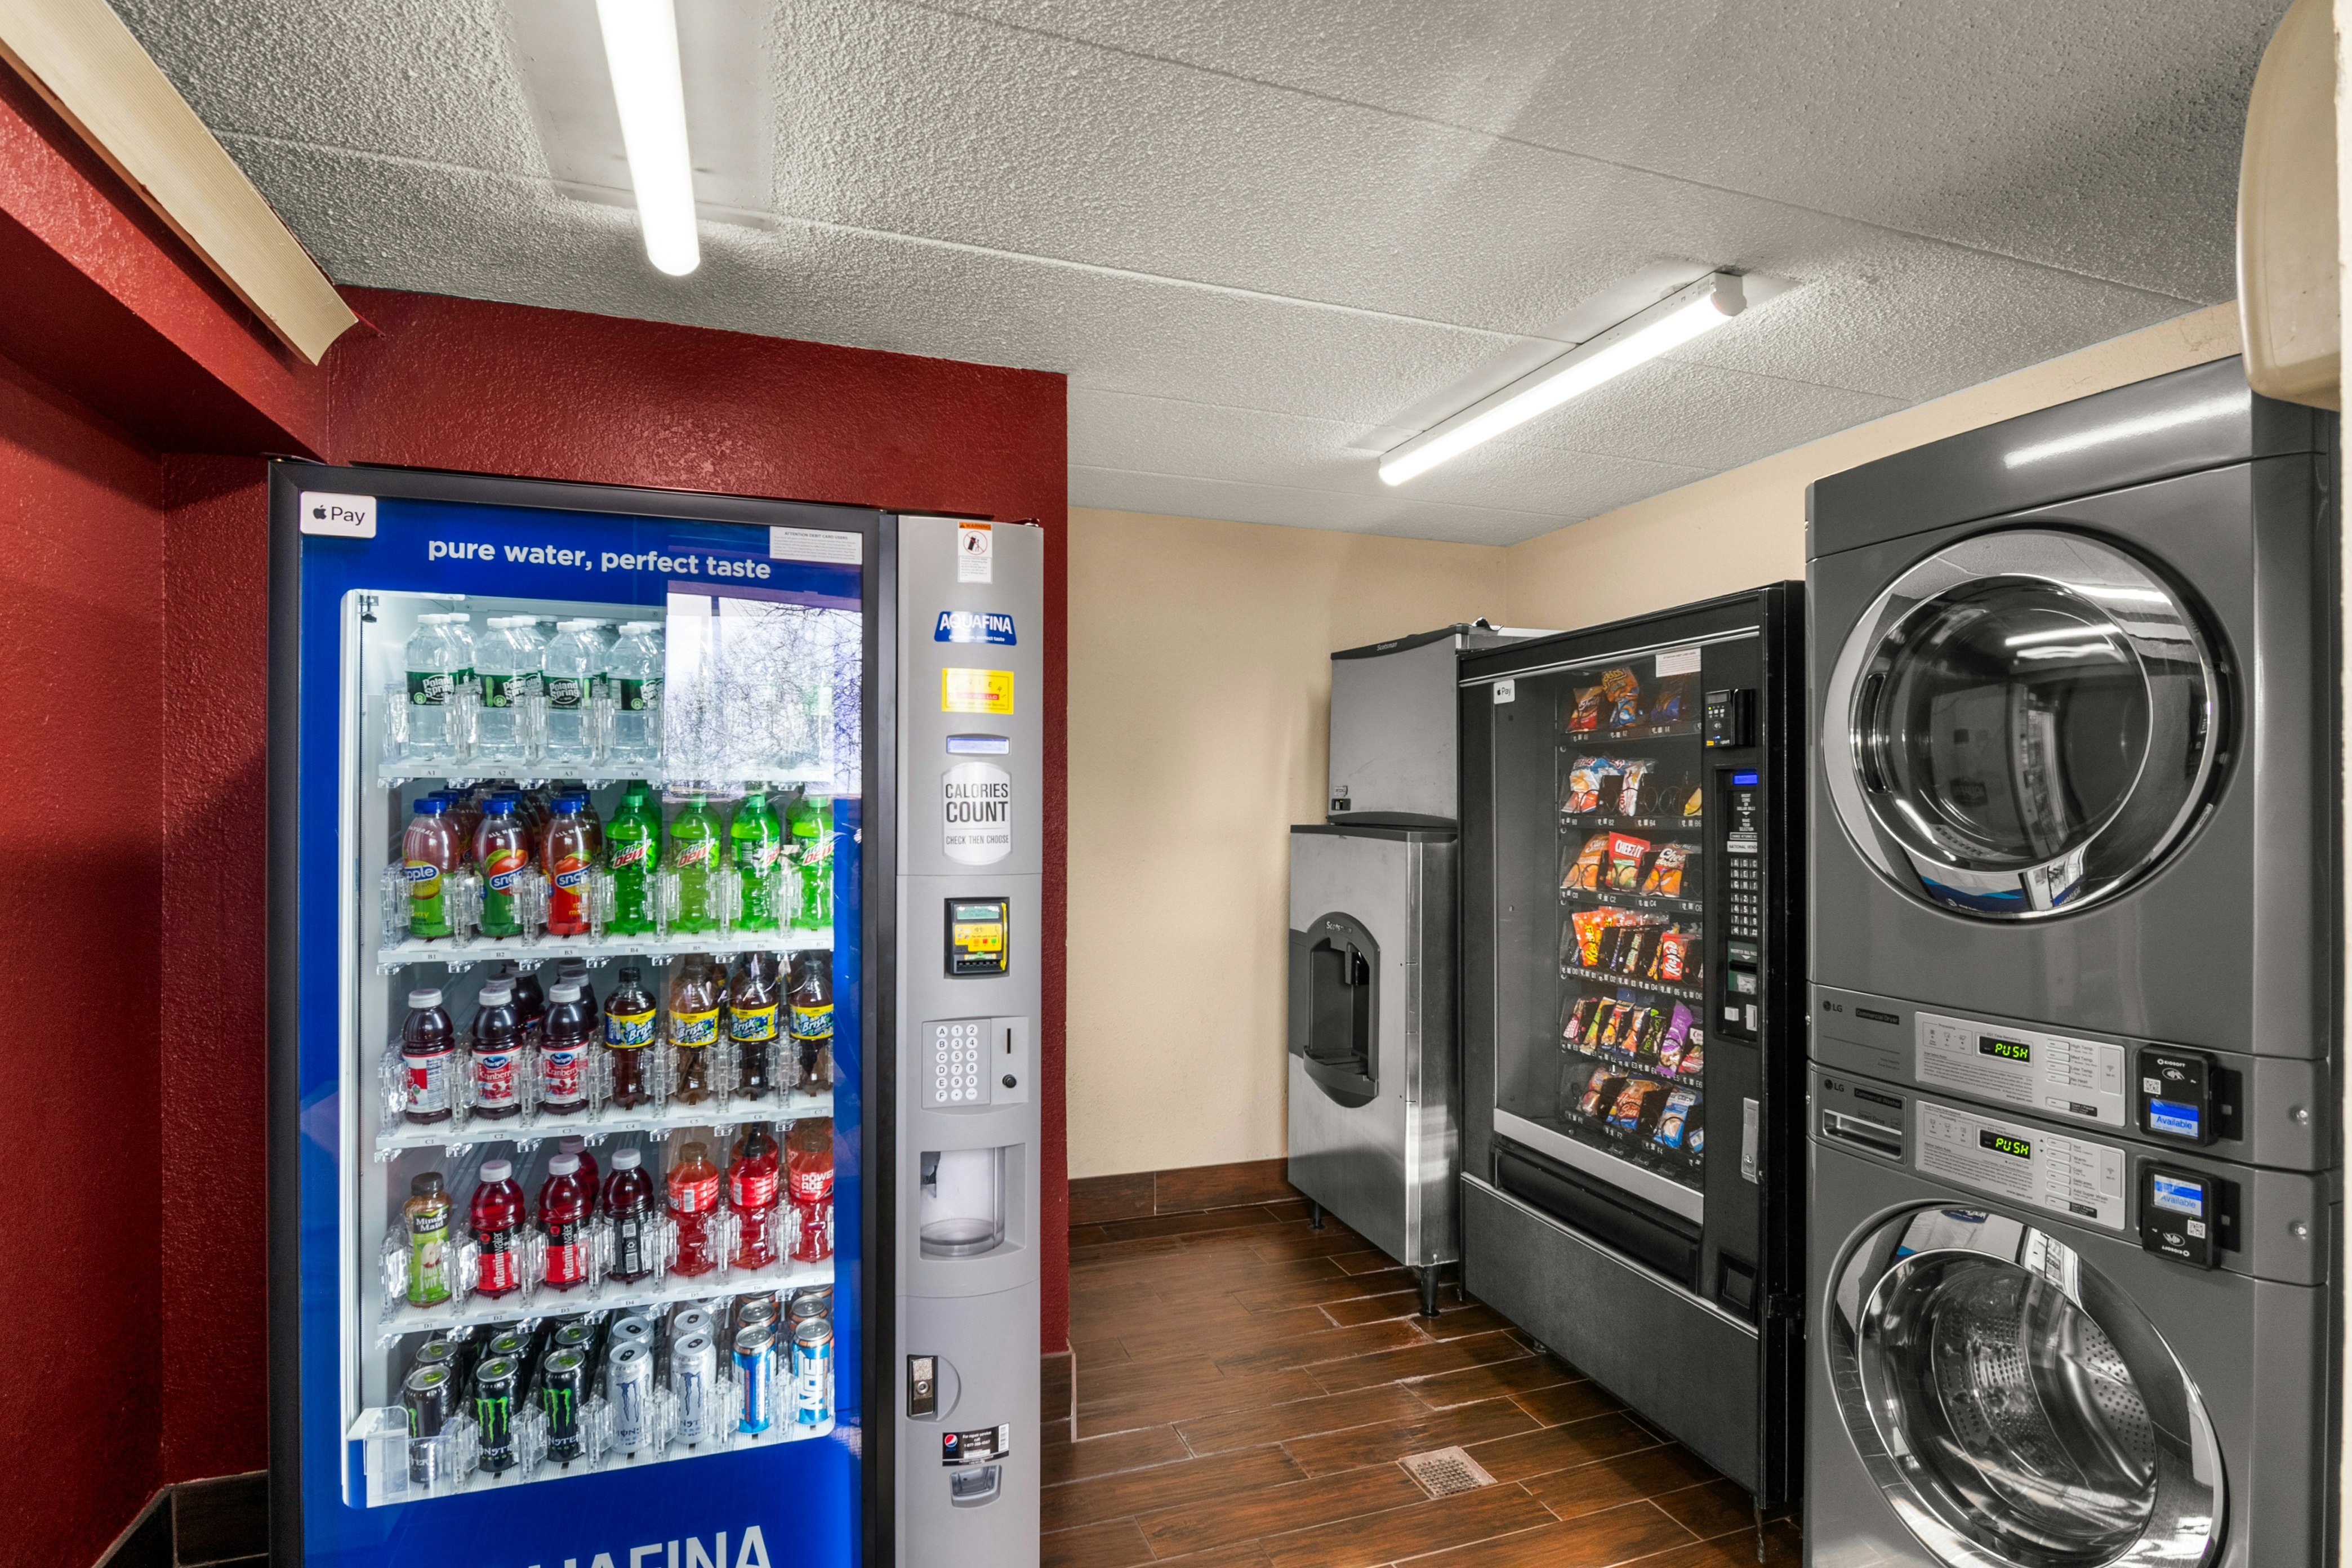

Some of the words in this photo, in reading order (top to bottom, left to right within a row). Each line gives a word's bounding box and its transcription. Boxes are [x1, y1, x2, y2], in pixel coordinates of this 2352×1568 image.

[331, 506, 365, 526] Pay
[429, 540, 496, 561] pure
[504, 545, 592, 571] water,
[601, 551, 698, 574] perfect
[707, 556, 770, 579] taste
[939, 613, 1013, 634] AQUAFINA
[422, 676, 453, 689] Poland
[503, 681, 525, 692] Polan
[550, 680, 578, 691] Poland
[425, 684, 455, 698] Spring
[551, 688, 581, 701] Spring
[1502, 687, 1511, 696] Pay
[945, 783, 1009, 799] CALORIES
[946, 801, 1009, 823] COUNT
[946, 835, 966, 845] CHECK
[969, 835, 984, 844] THEN
[986, 835, 1009, 844] CHOOSE
[1659, 848, 1686, 861] Chee
[1832, 1003, 1843, 1012] LG
[1995, 1043, 2028, 1058] PUSH
[1834, 1083, 1844, 1092] LG
[2157, 1116, 2193, 1130] Available
[1995, 1138, 2029, 1155] PUSH
[801, 1169, 834, 1182] POWE
[801, 1181, 823, 1190] ADE
[2160, 1195, 2196, 1208] Available
[416, 1212, 448, 1226] Minute
[420, 1220, 444, 1232] Maid
[563, 1224, 573, 1280] vitaminwater
[494, 1232, 506, 1288] vitaminwater
